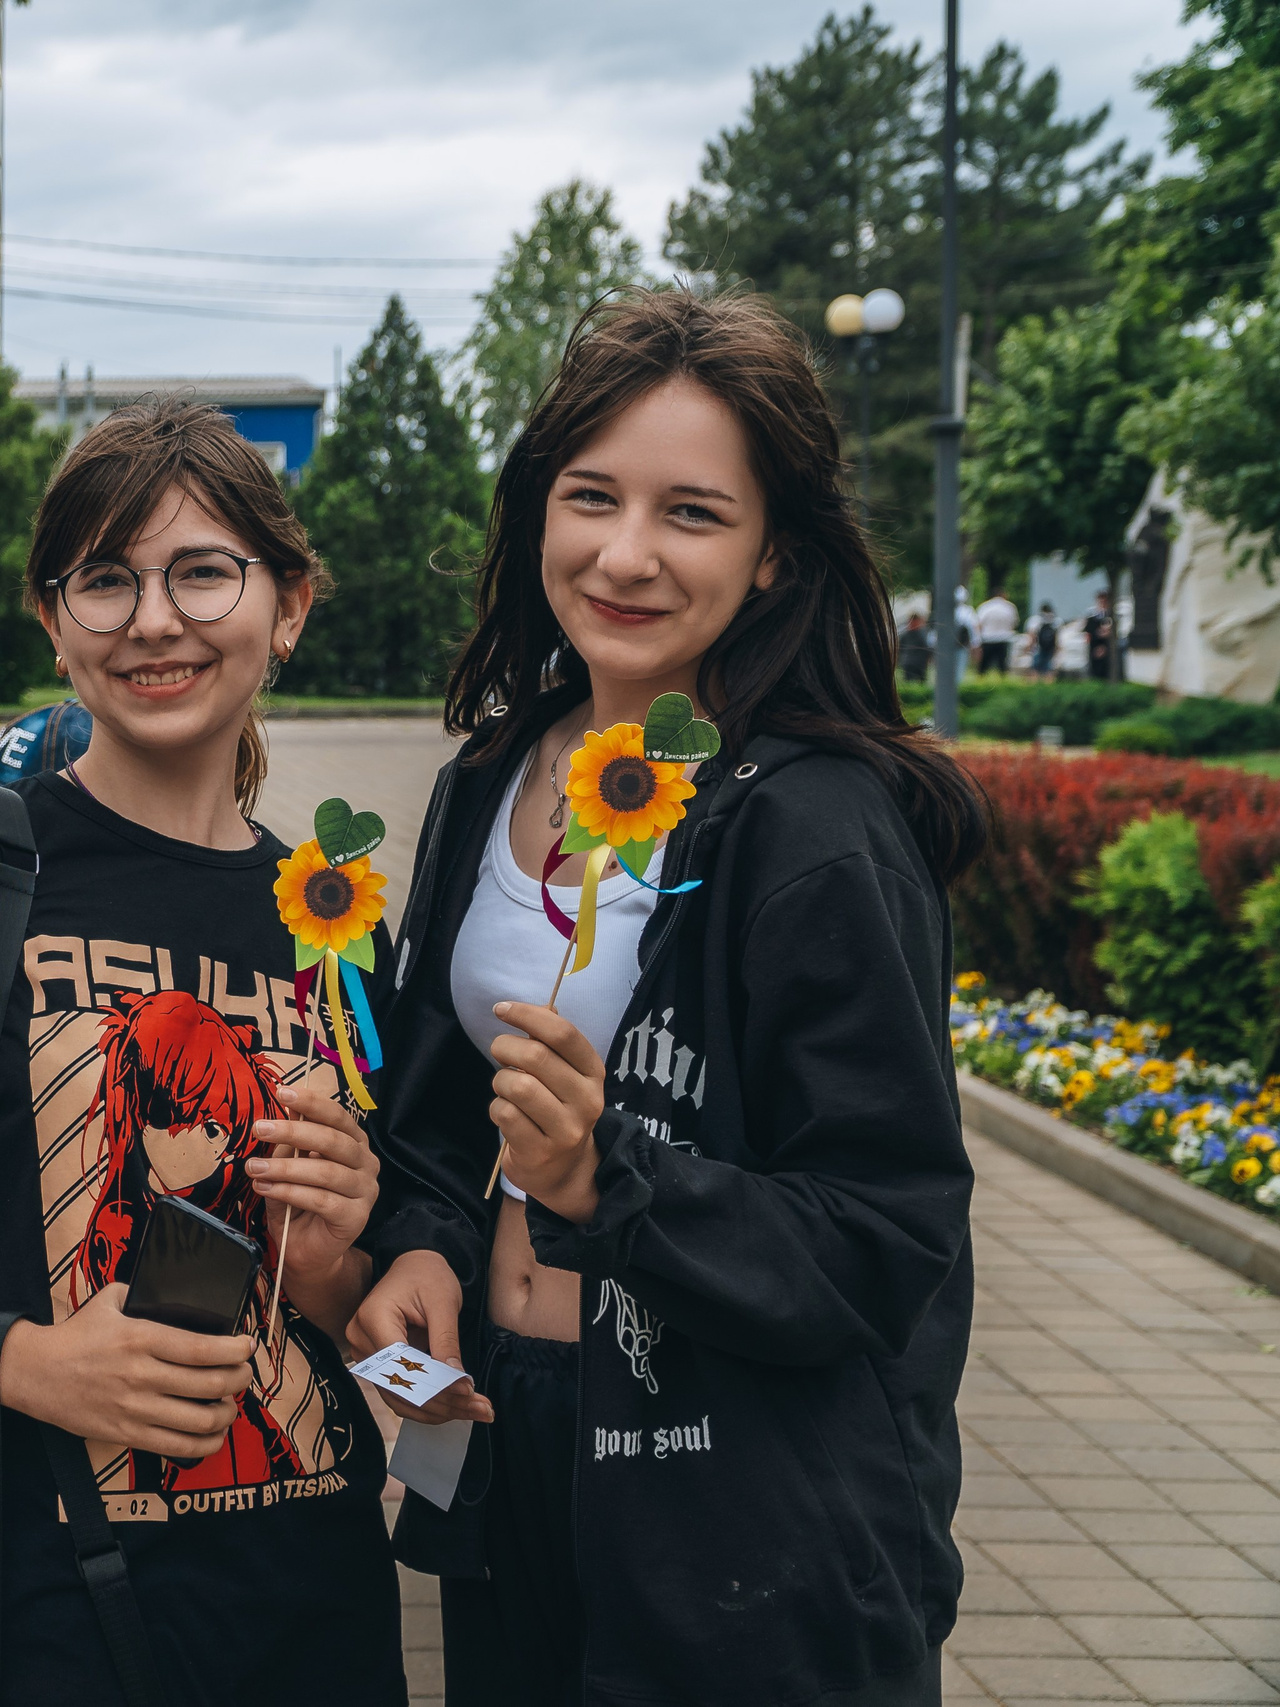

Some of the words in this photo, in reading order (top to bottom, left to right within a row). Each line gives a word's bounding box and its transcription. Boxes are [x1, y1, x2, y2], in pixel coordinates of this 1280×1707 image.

[664, 752, 690, 760] Динской
[690, 751, 709, 761] район
[653, 1414, 712, 1460] soul
[173, 1487, 256, 1515] OUTFIT
[263, 1481, 280, 1507] BY
[283, 1471, 349, 1500] TISHKA
